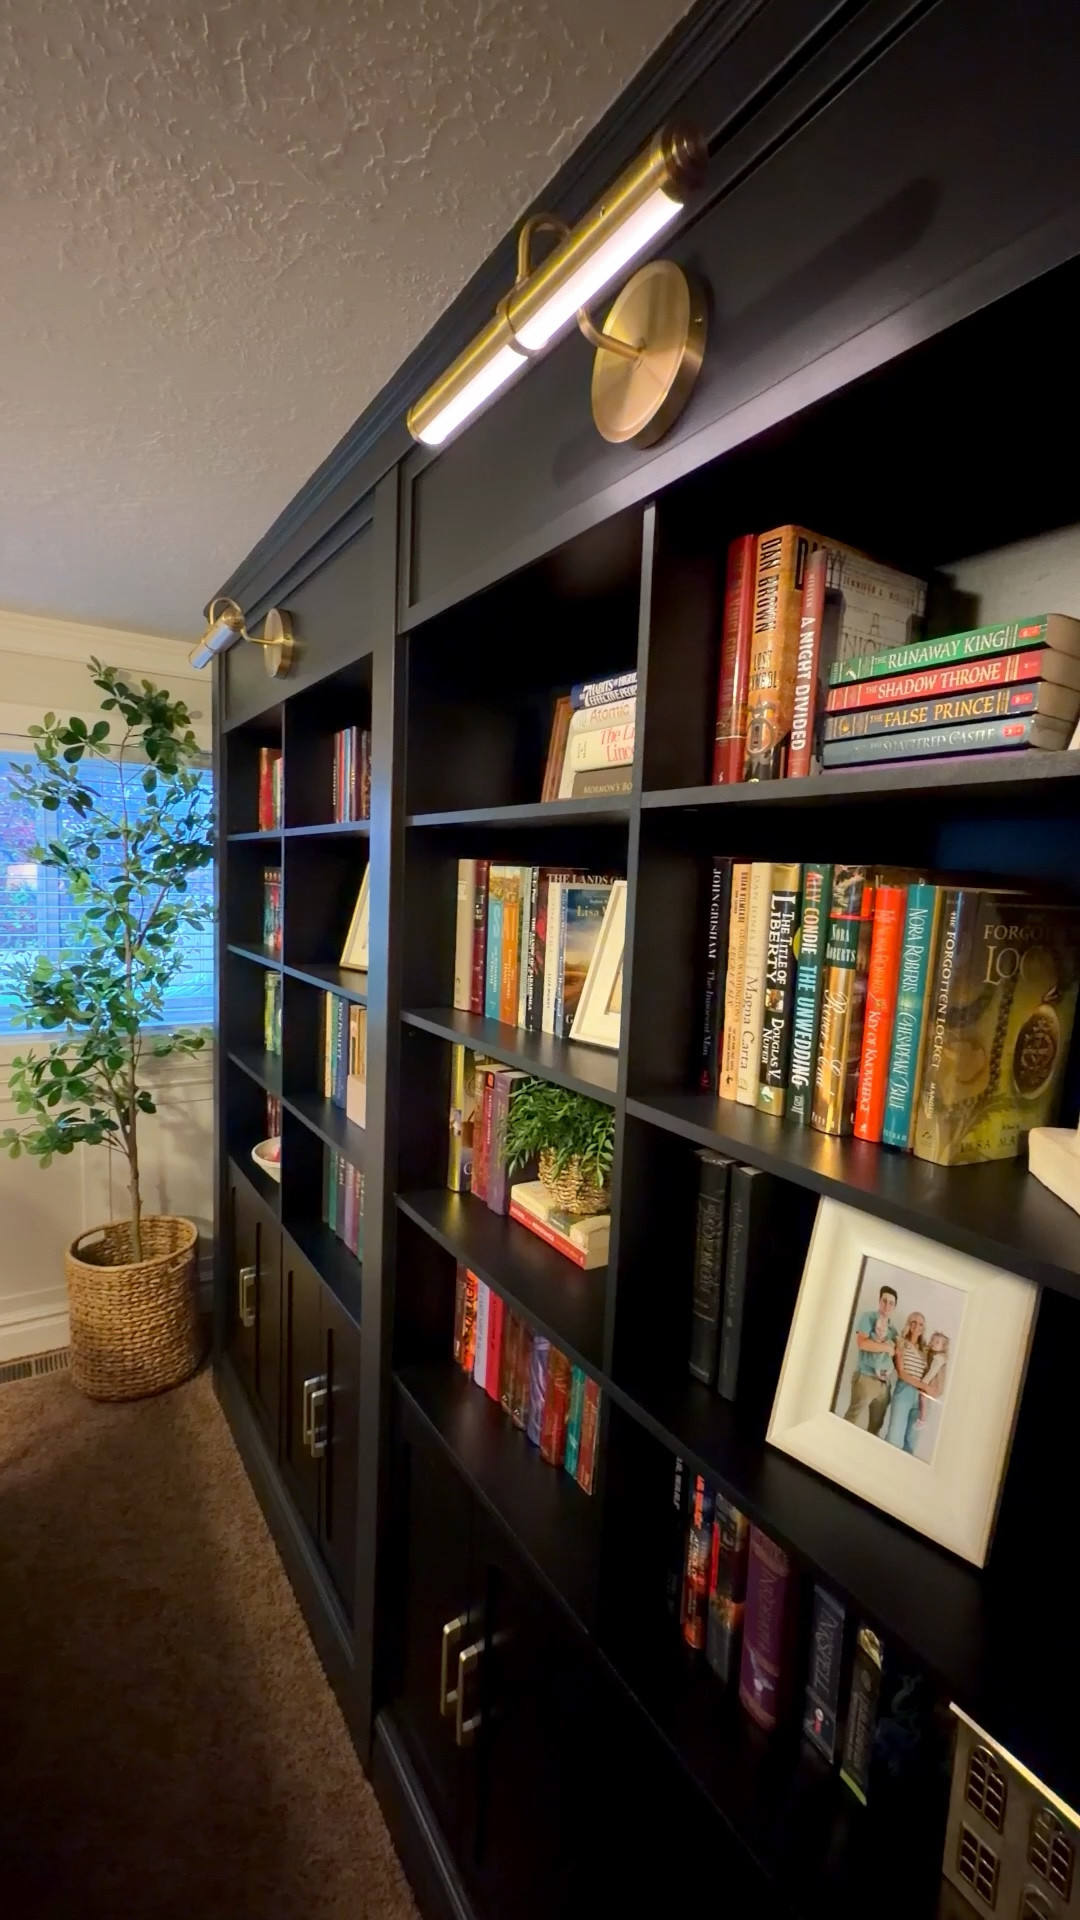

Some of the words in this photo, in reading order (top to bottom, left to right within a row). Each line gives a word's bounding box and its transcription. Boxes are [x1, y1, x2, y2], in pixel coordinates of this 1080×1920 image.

[759, 536, 783, 573] DAN
[754, 575, 780, 635] BROWN
[800, 616, 817, 629] A
[870, 612, 881, 636] A
[723, 638, 737, 667] CODE
[797, 630, 815, 679] NIGHT
[874, 656, 888, 666] THE
[888, 640, 962, 669] RUNAWAY
[963, 629, 1006, 654] KING
[583, 684, 591, 707] 7
[620, 683, 638, 699] PEOP
[865, 685, 878, 695] THE
[877, 674, 937, 700] SHADOW
[940, 662, 1003, 690] THRONE
[589, 702, 630, 720] Atomic
[790, 684, 811, 751] DIVIDED
[869, 714, 884, 723] THE
[884, 706, 929, 729] FALSE
[933, 695, 995, 723] PRINCE
[600, 727, 621, 745] The
[948, 728, 995, 745] CASTLE
[622, 782, 634, 792] BO
[547, 873, 569, 884] THE
[571, 874, 608, 885] LANDS
[712, 868, 722, 901] JOHN
[805, 871, 824, 903] ALLY
[576, 905, 600, 917] Lisa
[780, 912, 795, 935] THE
[906, 907, 929, 941] NORA
[708, 902, 720, 959] GRISHAM
[766, 894, 797, 984] LIBERTY
[801, 907, 820, 955] CONDIE
[777, 936, 793, 968] TITLE
[901, 943, 925, 993] ROBERTS
[707, 969, 716, 987] The
[776, 968, 788, 985] OF
[797, 965, 818, 992] THE
[937, 930, 957, 1014] FORGOTTEN
[703, 990, 714, 1033] Innocent
[743, 975, 758, 1025] Magna
[867, 1010, 881, 1032] KEY
[740, 1030, 755, 1069] Carta
[770, 1017, 785, 1068] DOUGLAS
[790, 997, 816, 1087] UNWEDDING
[866, 1034, 877, 1046] OF
[931, 1017, 947, 1069] LOCKET
[860, 1047, 878, 1113] KNOWLEDGE
